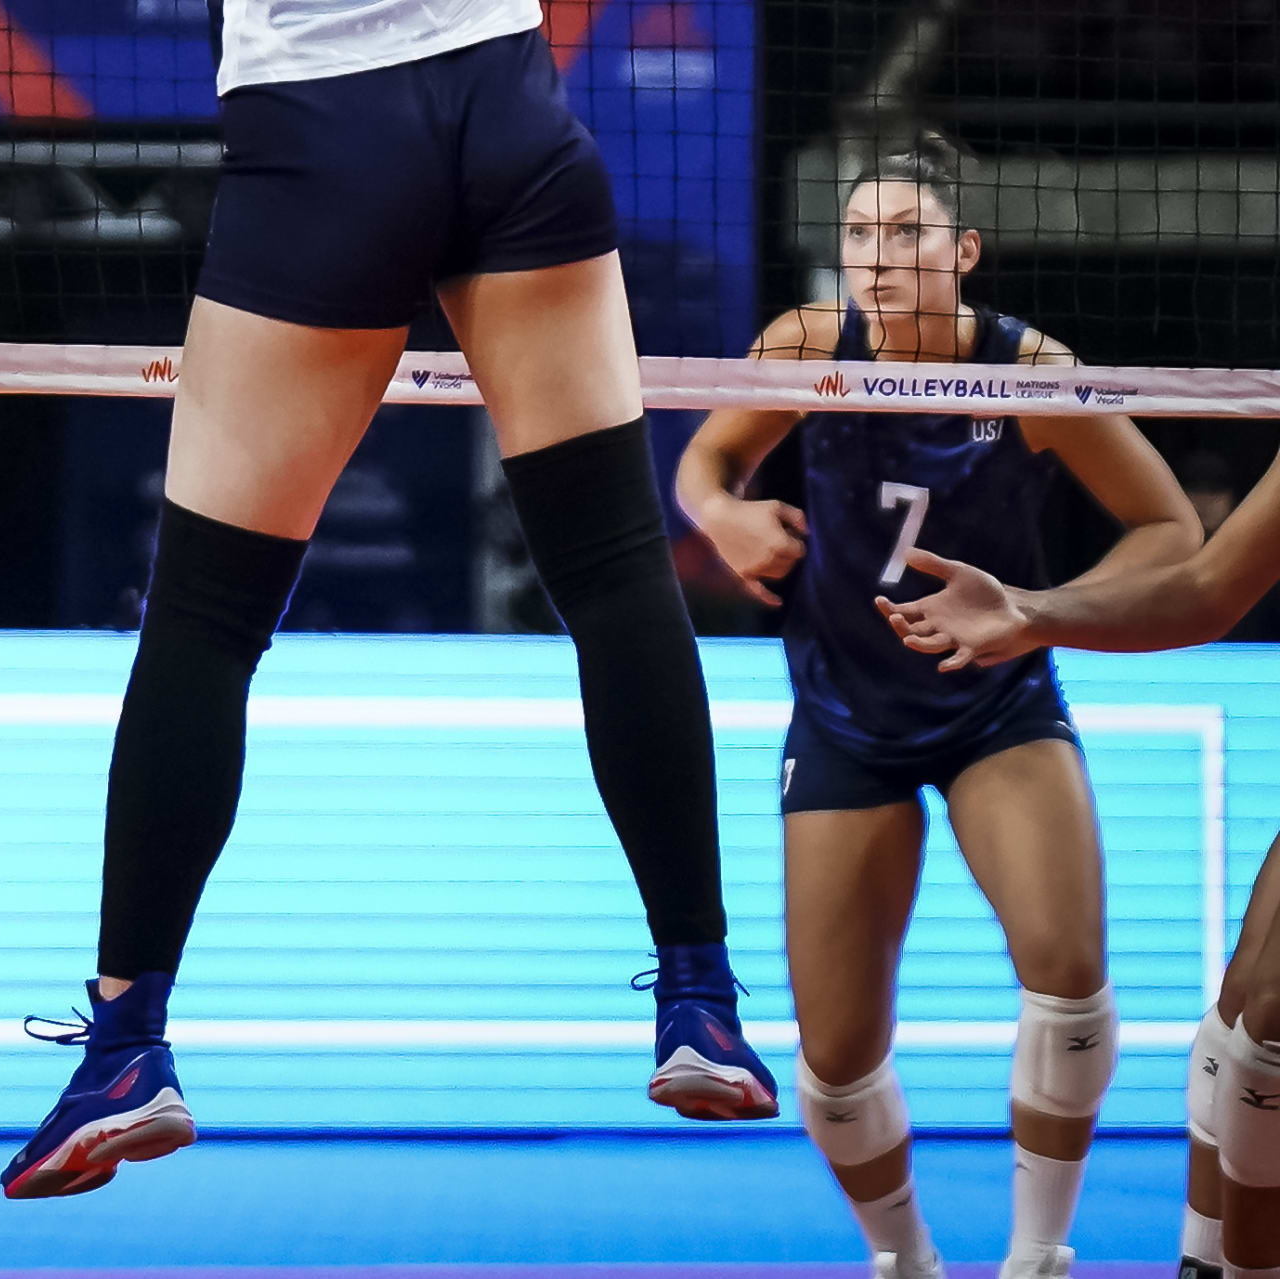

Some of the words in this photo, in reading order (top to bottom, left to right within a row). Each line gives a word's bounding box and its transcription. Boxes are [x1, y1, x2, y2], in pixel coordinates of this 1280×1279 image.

[142, 356, 179, 383] VNL
[814, 371, 851, 398] VNL
[863, 377, 1011, 399] VOLLEYBALL
[1016, 381, 1060, 389] NATIONS
[880, 481, 929, 584] 7
